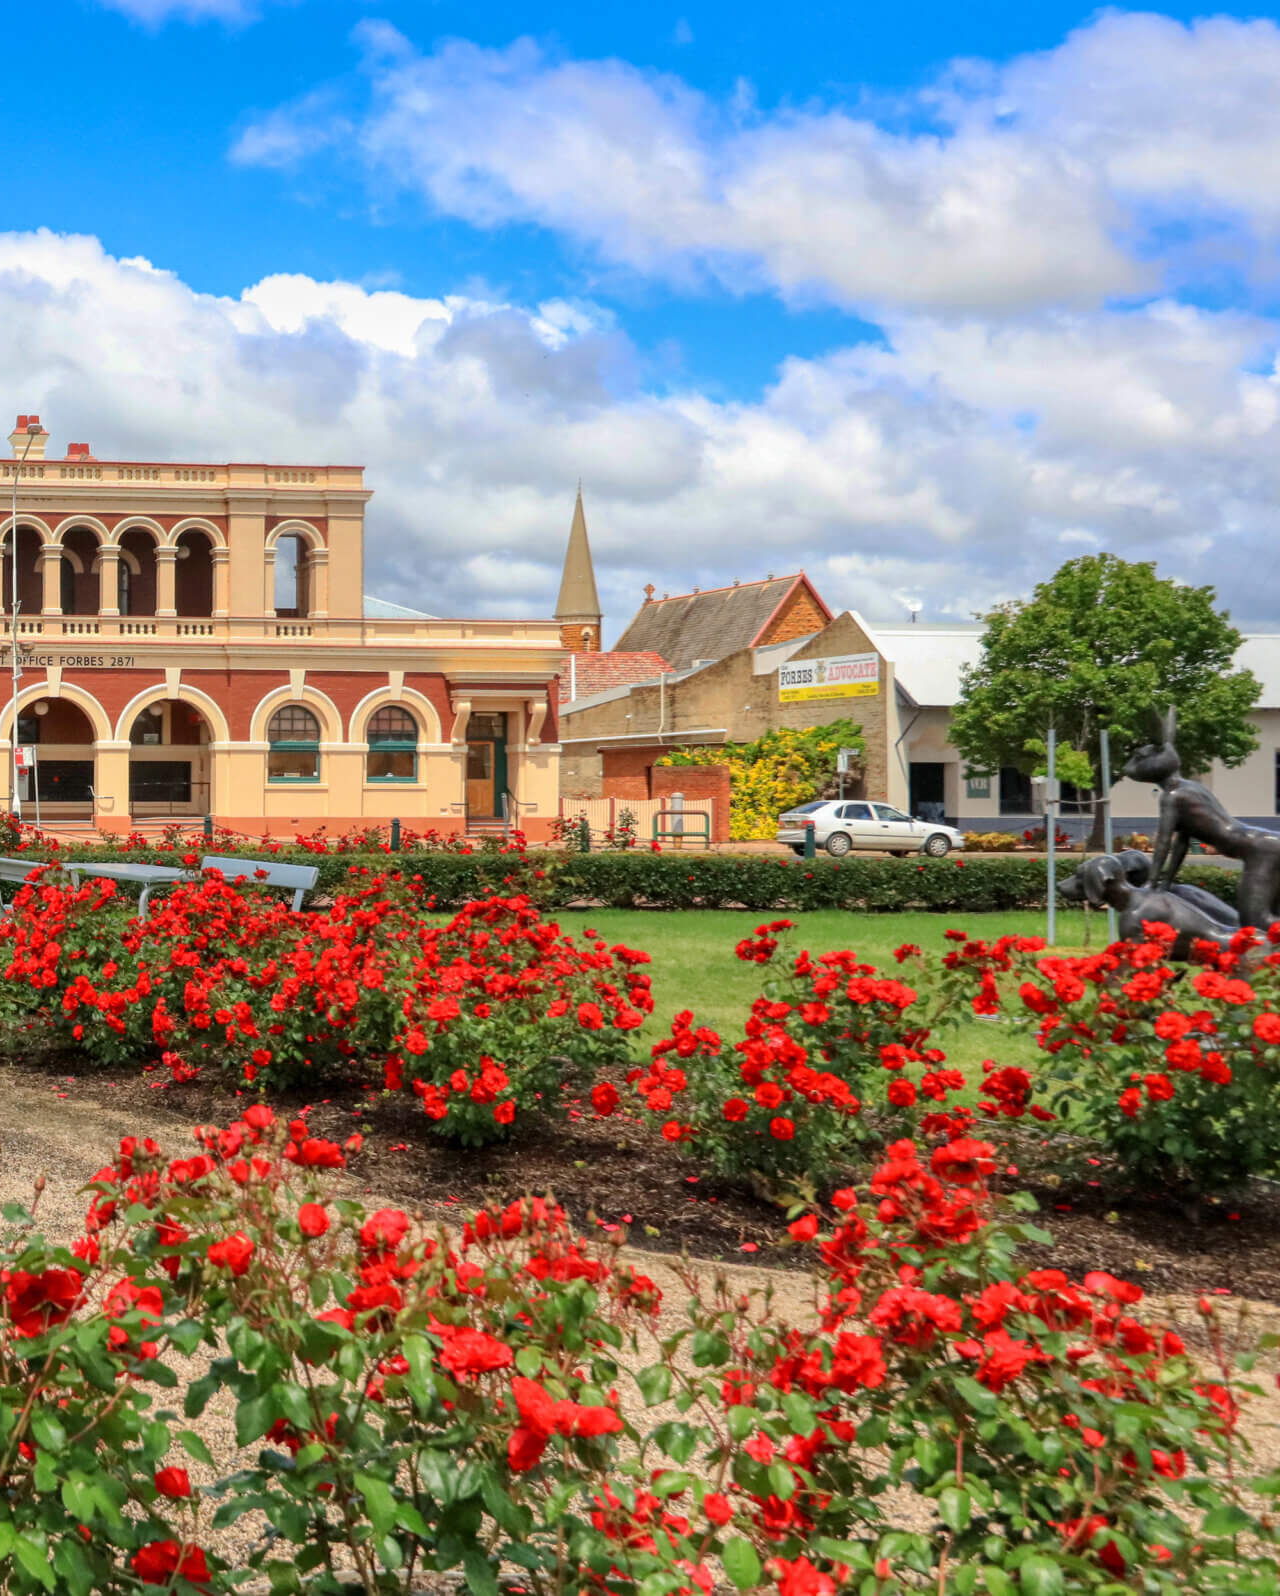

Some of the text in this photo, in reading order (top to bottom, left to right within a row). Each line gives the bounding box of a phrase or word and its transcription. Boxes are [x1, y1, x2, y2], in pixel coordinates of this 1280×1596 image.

[59, 656, 104, 666] FORBES
[110, 656, 135, 666] 2871
[780, 662, 878, 685] FORBES ADVOCATE
